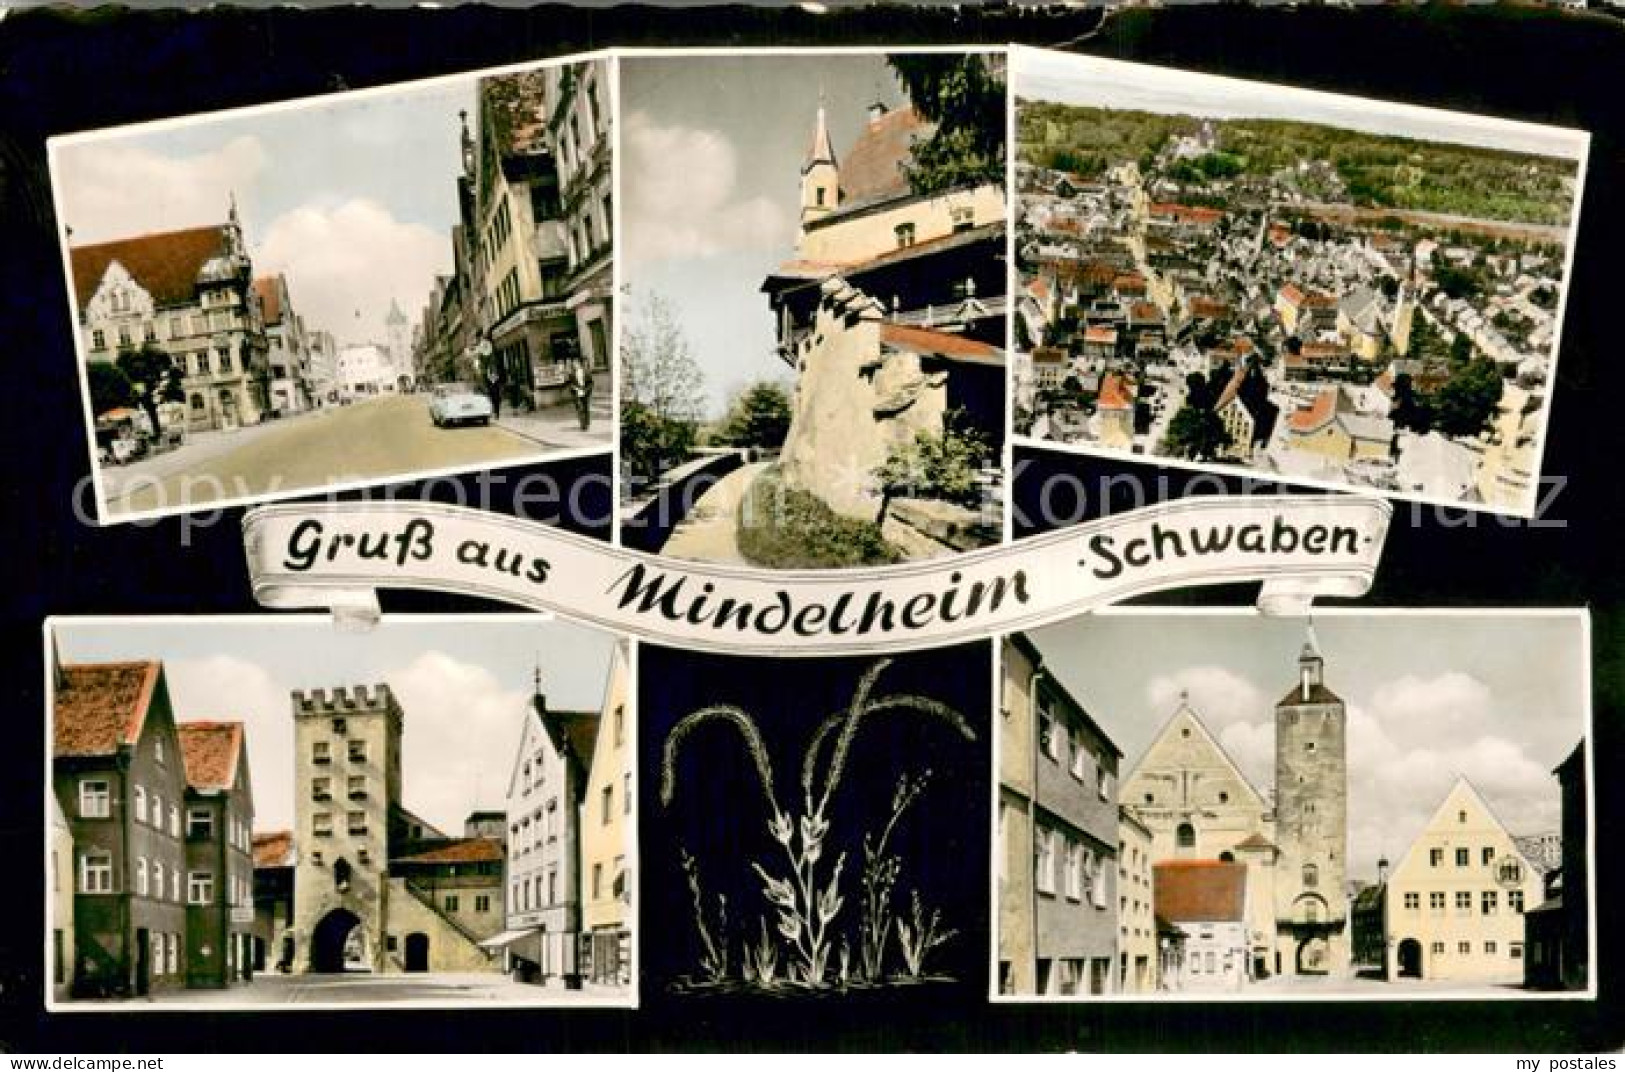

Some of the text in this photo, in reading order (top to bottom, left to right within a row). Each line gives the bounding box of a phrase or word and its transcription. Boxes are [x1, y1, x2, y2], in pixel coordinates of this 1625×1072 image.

[283, 518, 551, 584] Gruß aus
[605, 563, 1029, 636] Mindelheim
